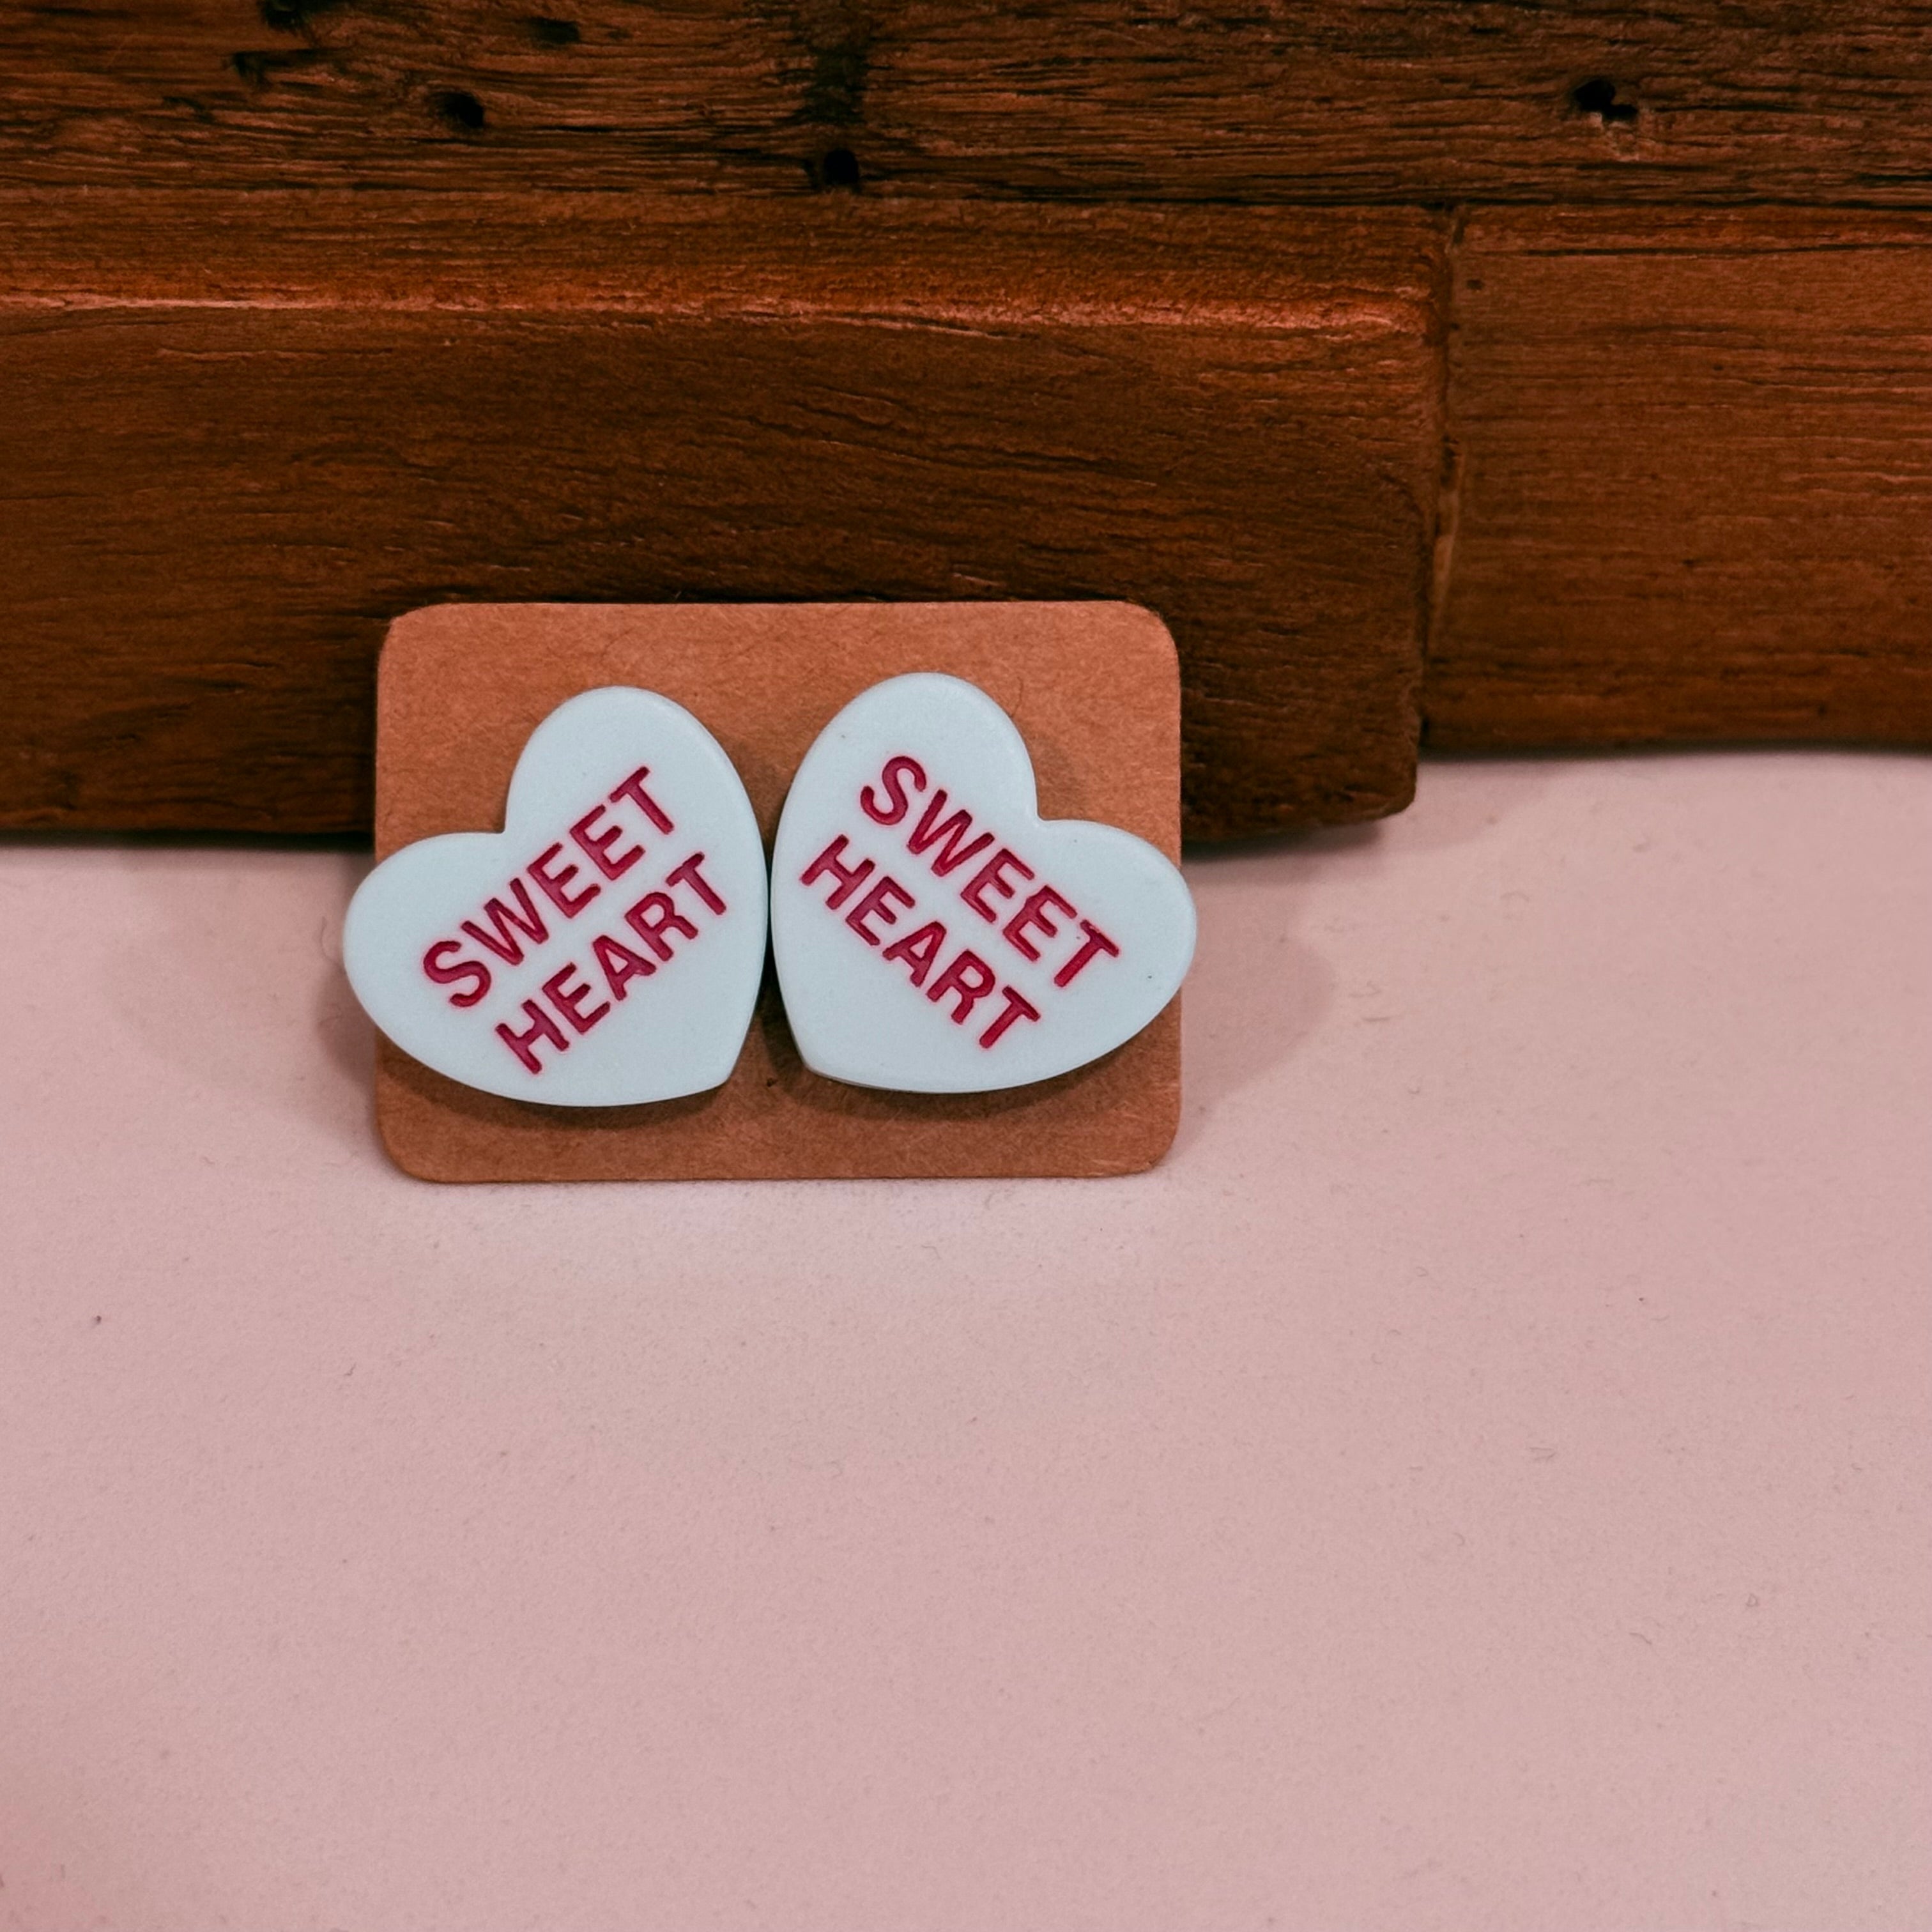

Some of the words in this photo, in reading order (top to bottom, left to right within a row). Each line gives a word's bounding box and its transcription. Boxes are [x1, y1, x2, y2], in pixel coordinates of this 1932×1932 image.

[422, 766, 677, 1009] SWEET
[495, 852, 727, 1075] HEART
[801, 834, 1041, 1050] HEART
[861, 755, 1121, 988] SWEET
